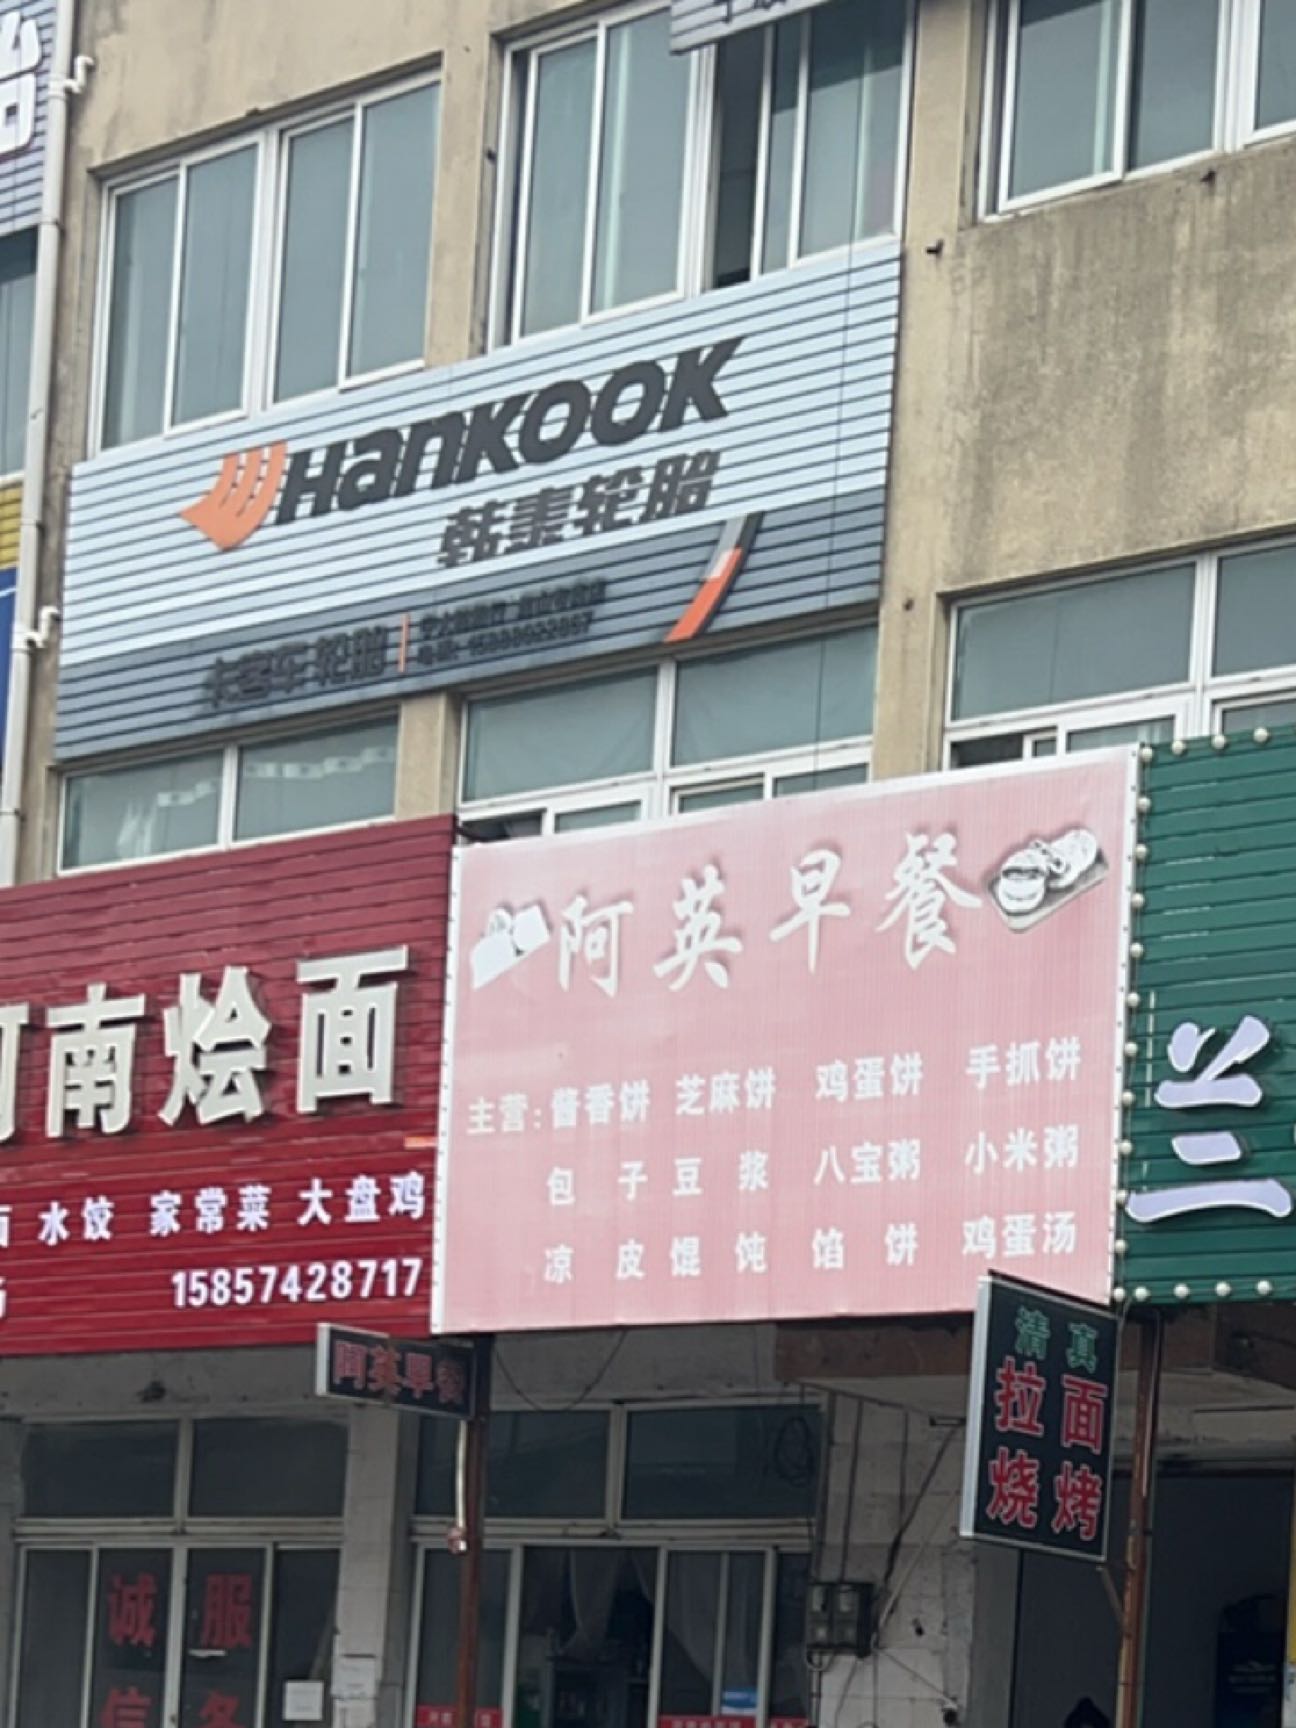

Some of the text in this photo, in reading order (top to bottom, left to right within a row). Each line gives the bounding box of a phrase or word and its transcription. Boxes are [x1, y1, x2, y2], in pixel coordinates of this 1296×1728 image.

[557, 830, 984, 997] 阿英早餐
[675, 1068, 776, 1117] 芝麻饼
[816, 1052, 924, 1101] 鸡蛋饼
[965, 1037, 1081, 1090] 手抓饼
[814, 1139, 921, 1186] 八宝粥
[965, 1125, 1079, 1175] 小米粥
[38, 1196, 114, 1246] 水饺
[149, 1185, 271, 1236] 家常菜
[297, 1171, 426, 1227] 大盘鸡
[962, 1211, 1077, 1260] 鸡蛋汤
[172, 1258, 423, 1308] 15857428717
[1014, 1305, 1098, 1373] 清真
[994, 1355, 1108, 1454] 拉面
[986, 1446, 1101, 1542] 烧烤
